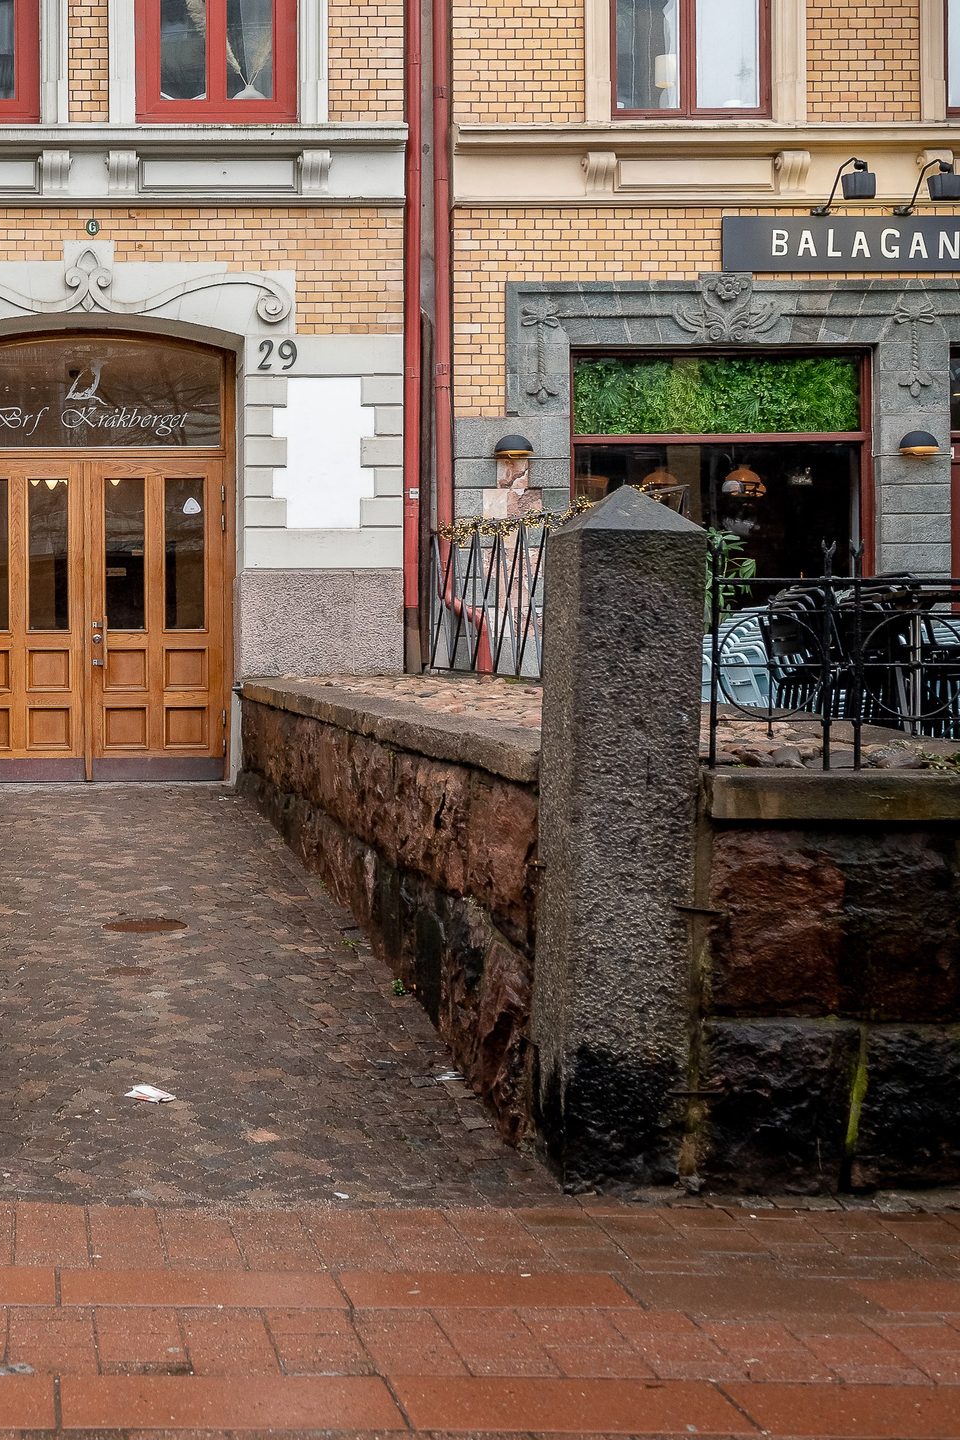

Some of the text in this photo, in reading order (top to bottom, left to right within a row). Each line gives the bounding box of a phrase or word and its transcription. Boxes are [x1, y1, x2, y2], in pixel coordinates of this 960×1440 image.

[771, 228, 960, 260] BALAGAN
[257, 339, 298, 370] 29
[60, 406, 189, 437] Kråkberget
